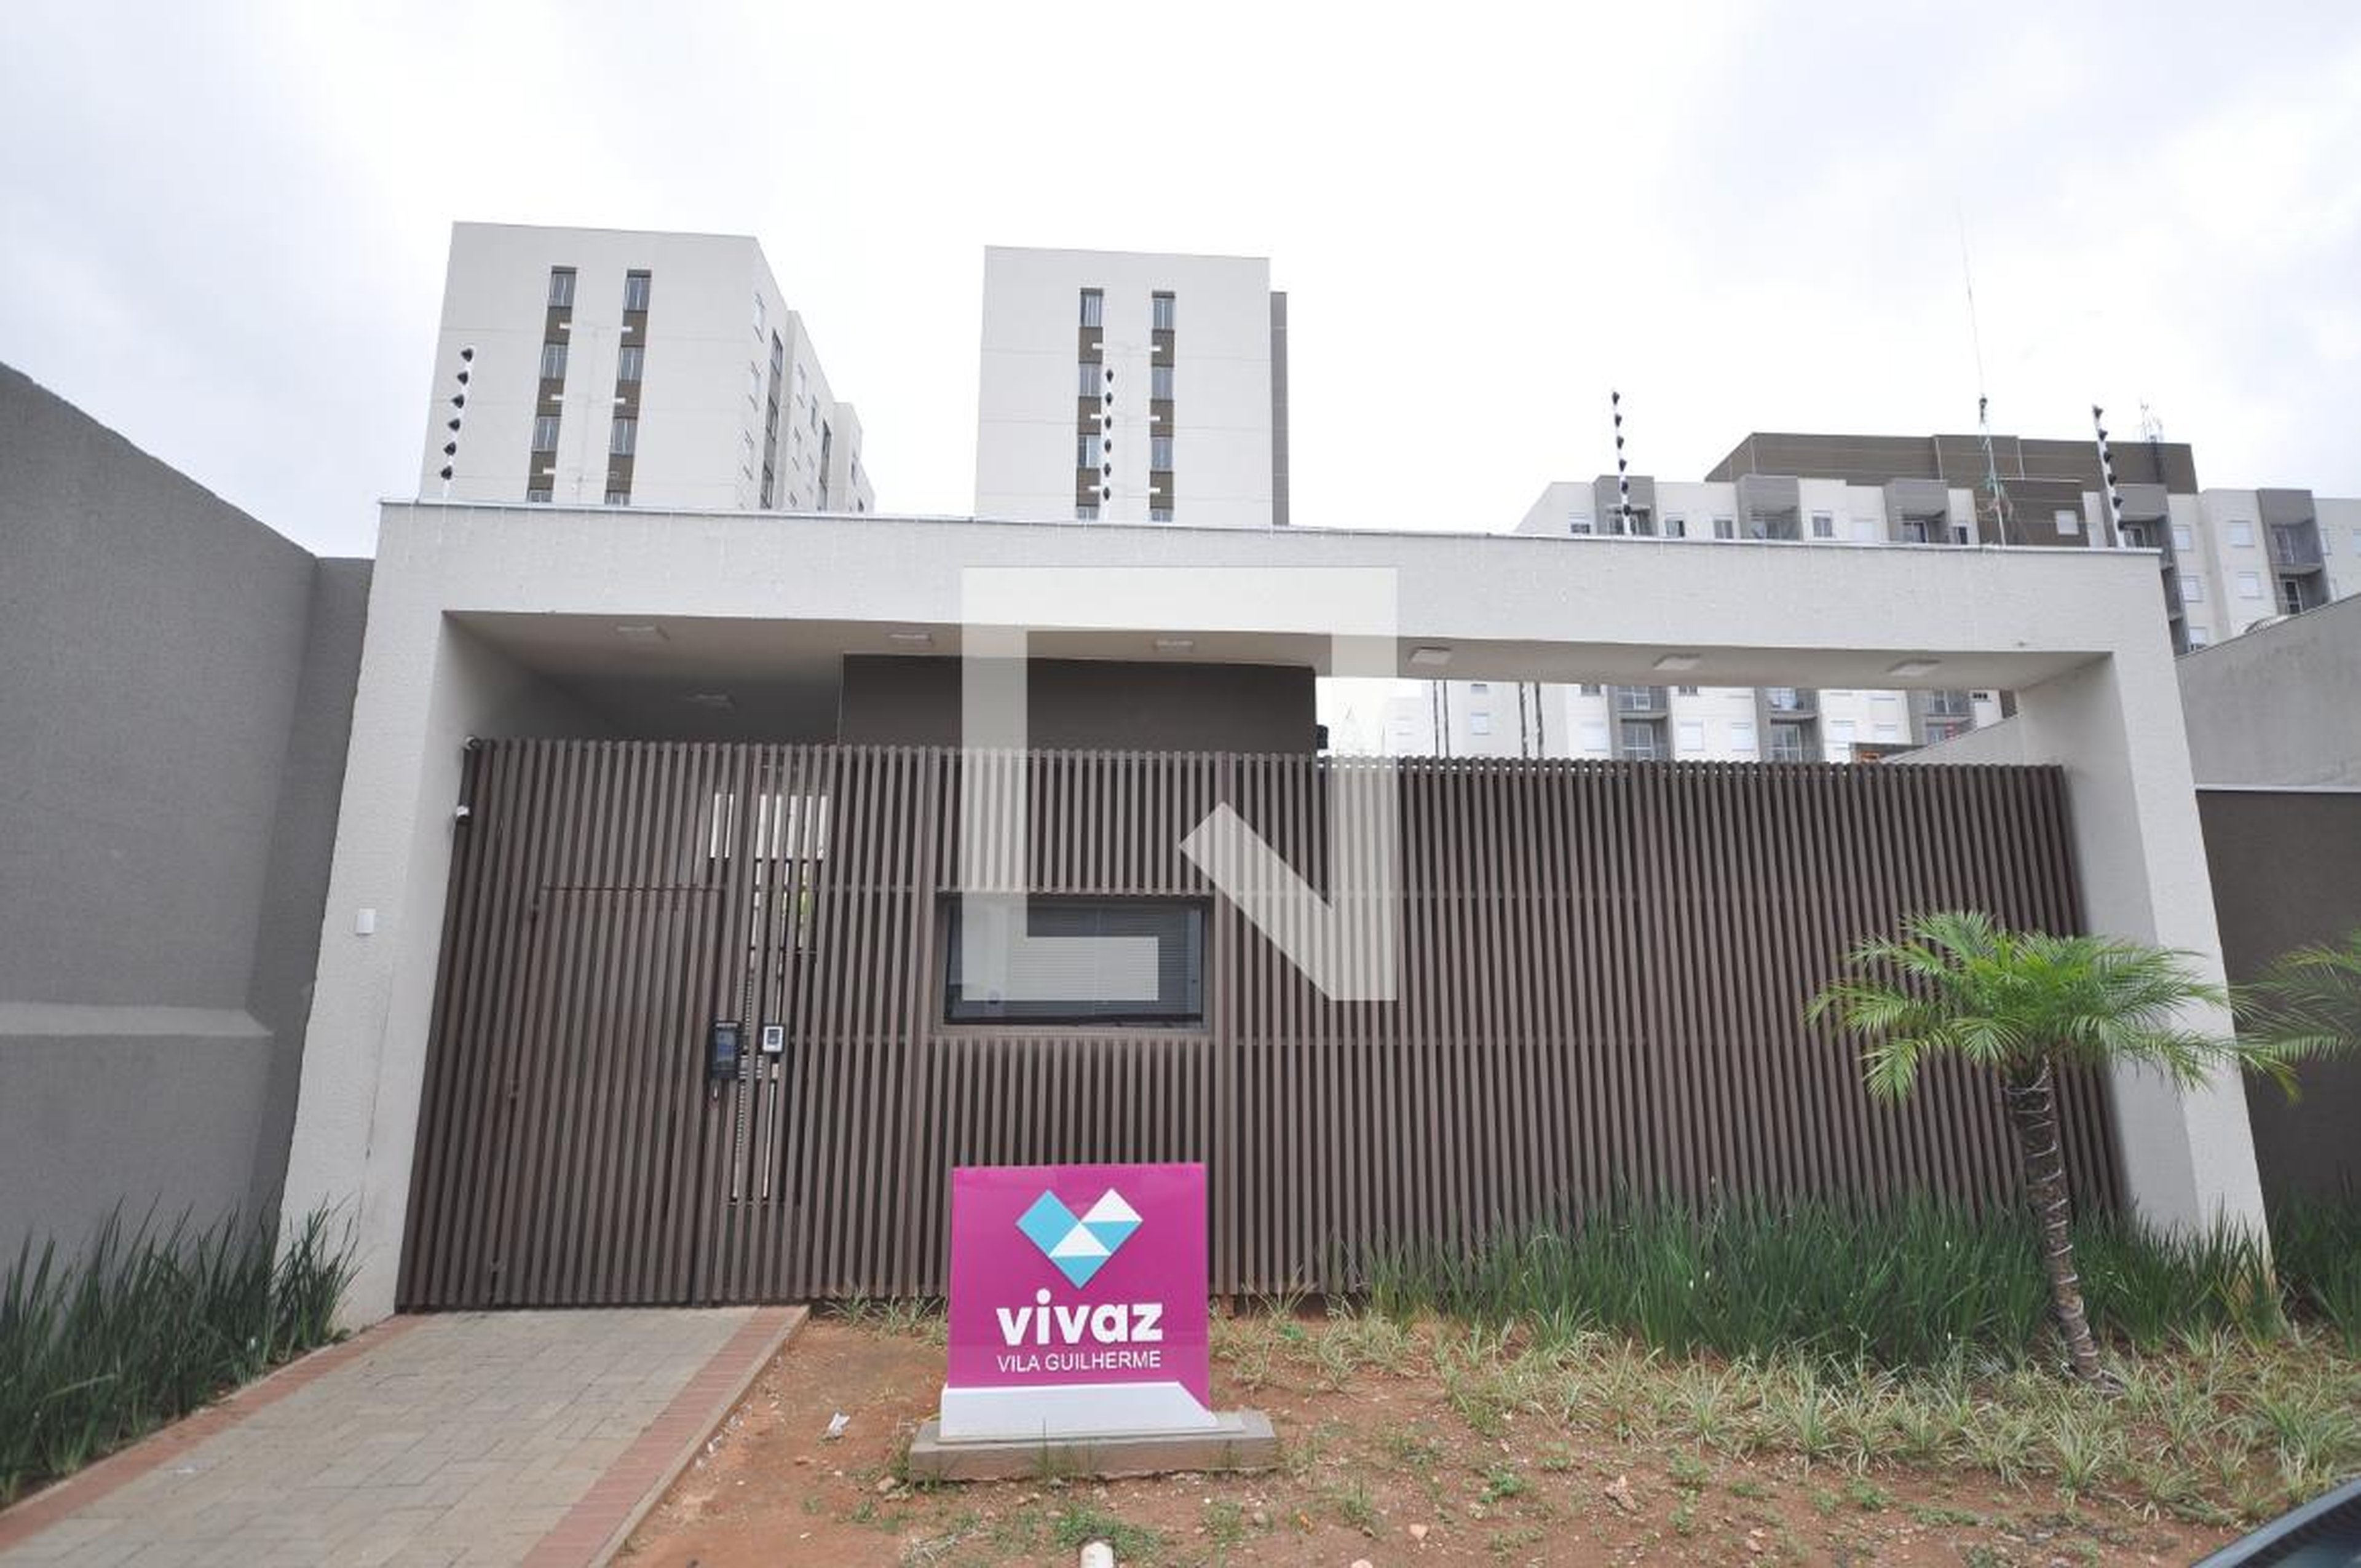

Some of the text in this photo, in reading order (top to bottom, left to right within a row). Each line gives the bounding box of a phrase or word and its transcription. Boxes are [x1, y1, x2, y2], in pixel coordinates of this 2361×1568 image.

[996, 1288, 1163, 1345] vivaz
[997, 1350, 1161, 1371] VILA GUILHERME
